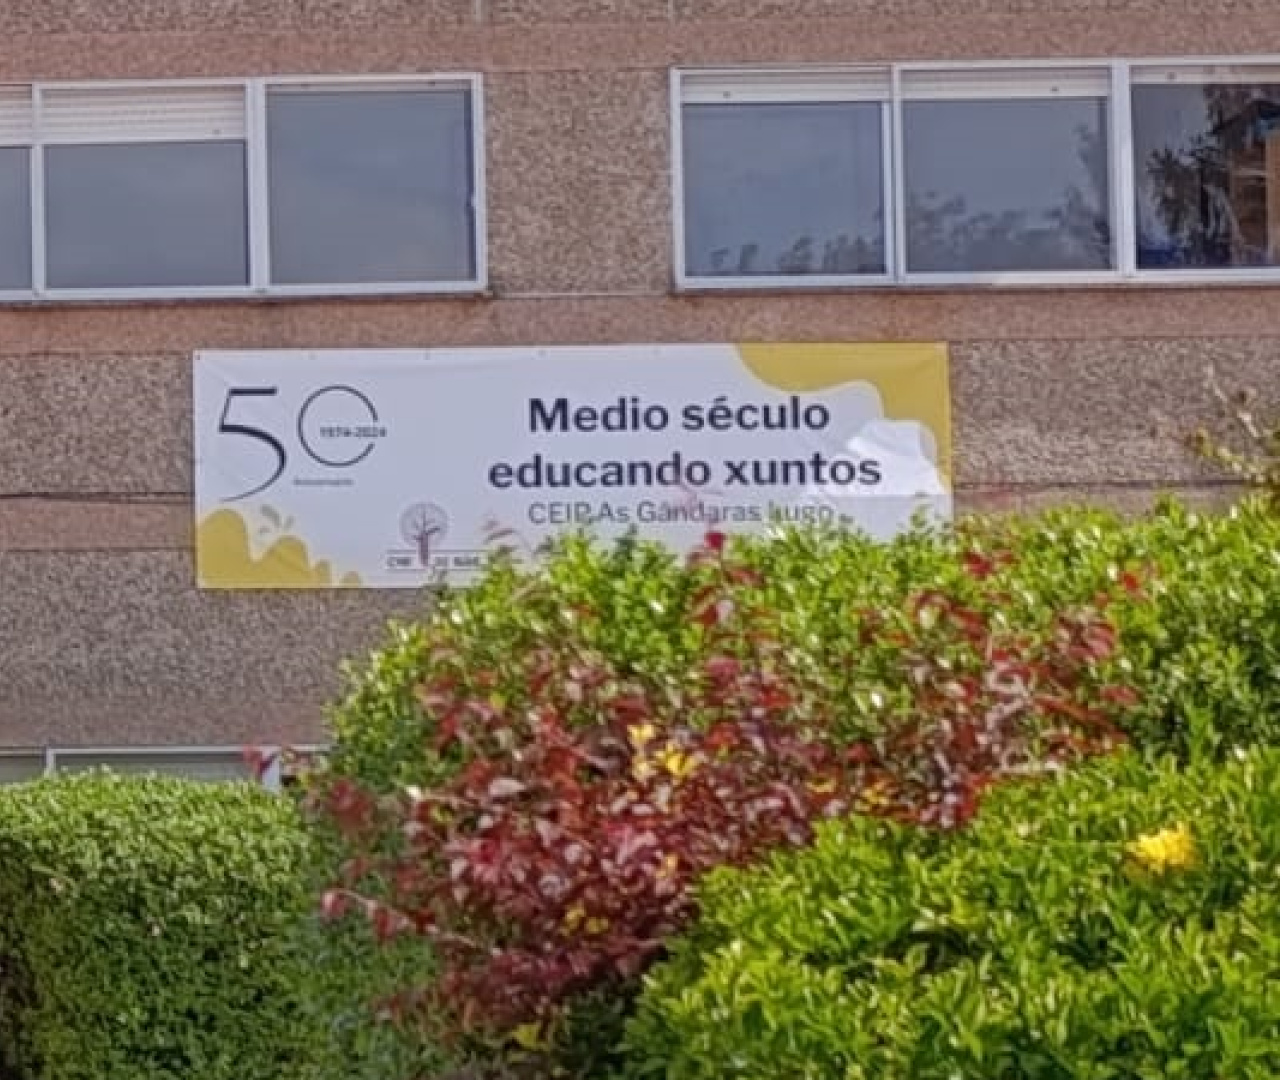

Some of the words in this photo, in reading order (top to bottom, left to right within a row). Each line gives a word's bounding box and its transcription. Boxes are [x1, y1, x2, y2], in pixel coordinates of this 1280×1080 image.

[529, 397, 669, 432] Medio
[681, 395, 830, 431] século
[488, 453, 711, 489] educando
[724, 452, 882, 485] xuntos
[598, 502, 630, 523] As
